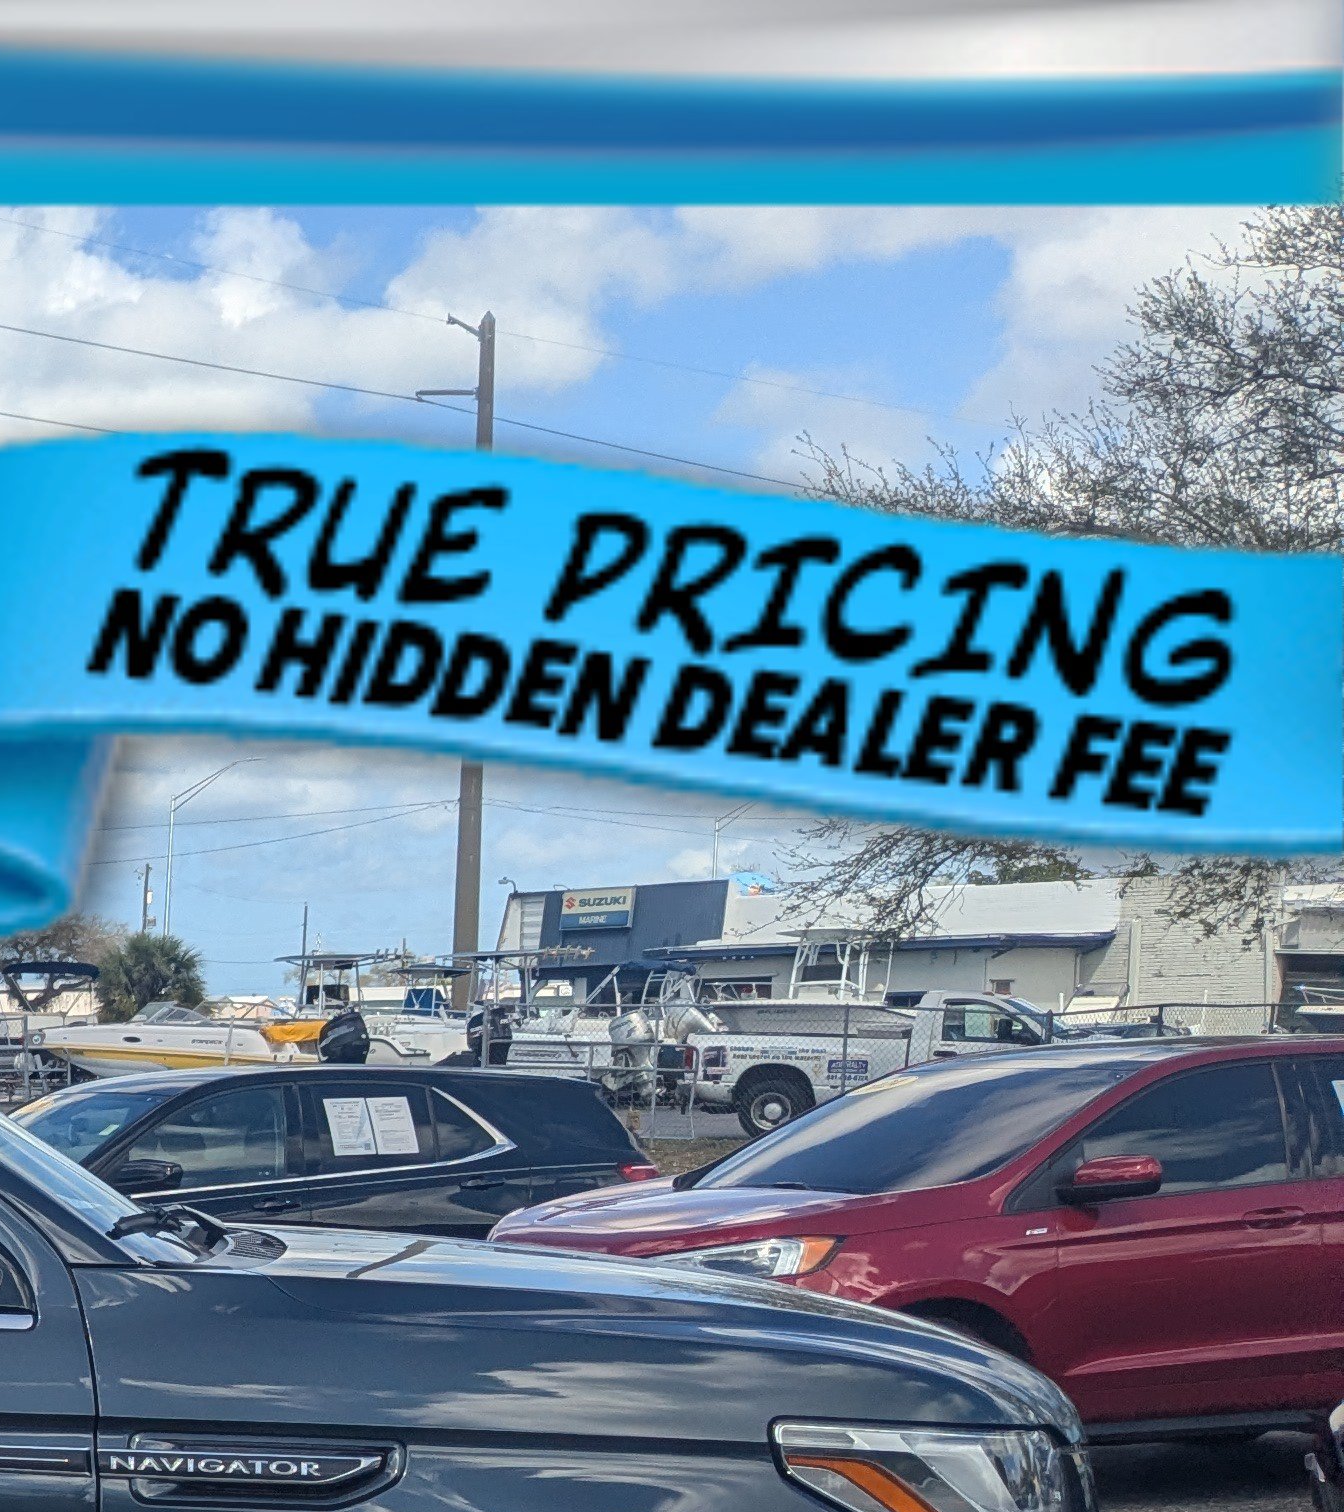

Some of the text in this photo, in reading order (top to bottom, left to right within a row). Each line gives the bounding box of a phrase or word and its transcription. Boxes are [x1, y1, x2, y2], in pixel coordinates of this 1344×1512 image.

[578, 896, 627, 908] SUZUKI
[578, 914, 608, 925] MARINE
[109, 1454, 321, 1477] NAVIGATOR
